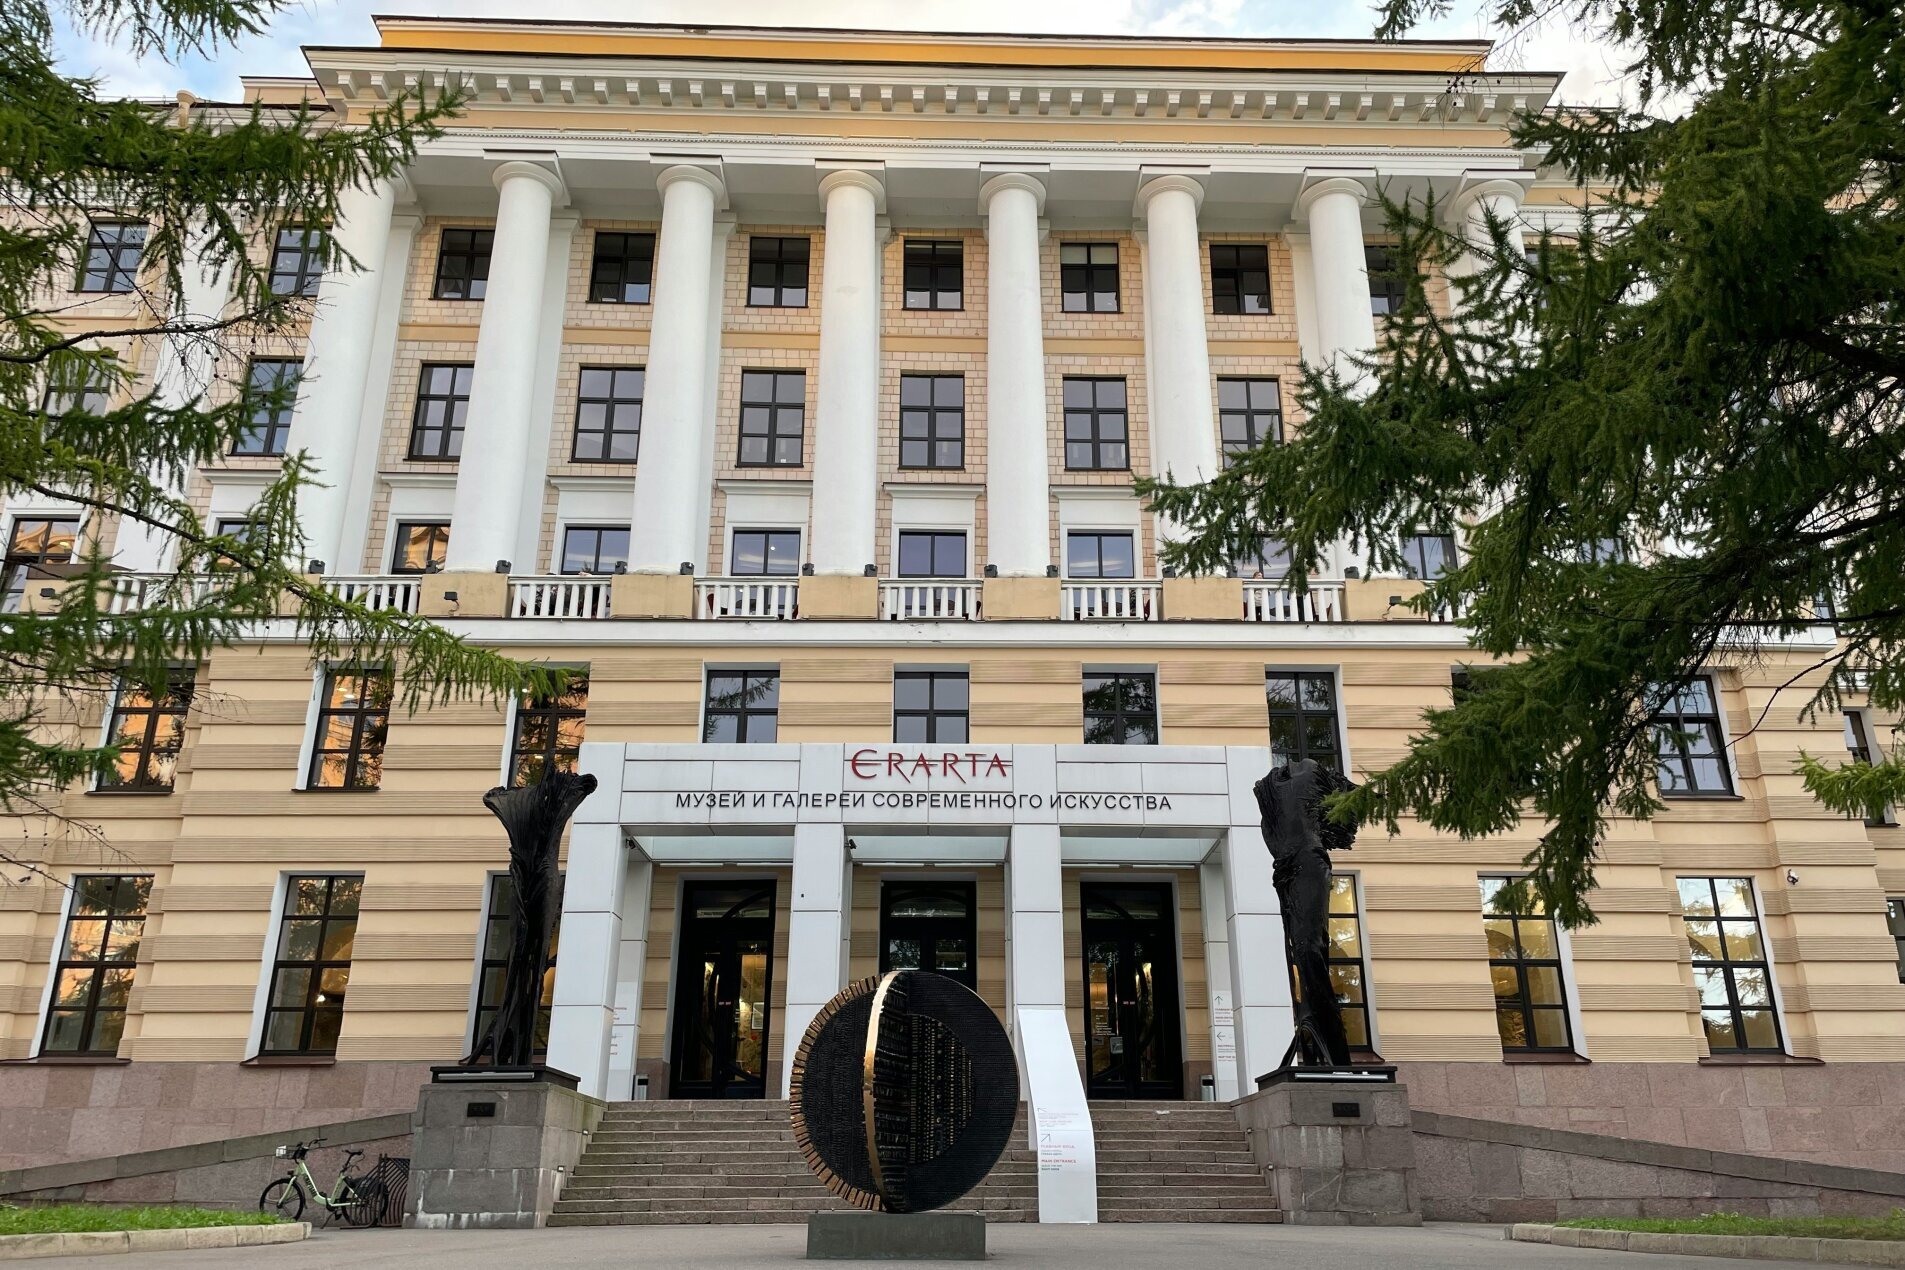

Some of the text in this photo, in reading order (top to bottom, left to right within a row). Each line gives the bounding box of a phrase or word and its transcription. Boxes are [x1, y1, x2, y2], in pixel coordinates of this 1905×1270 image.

[851, 748, 1011, 784] ERARTA
[676, 791, 1172, 811] МУЗЕЙ И ГАЛЕРЕИ СОВРЕМЕННОГО ИСКУССТВА
